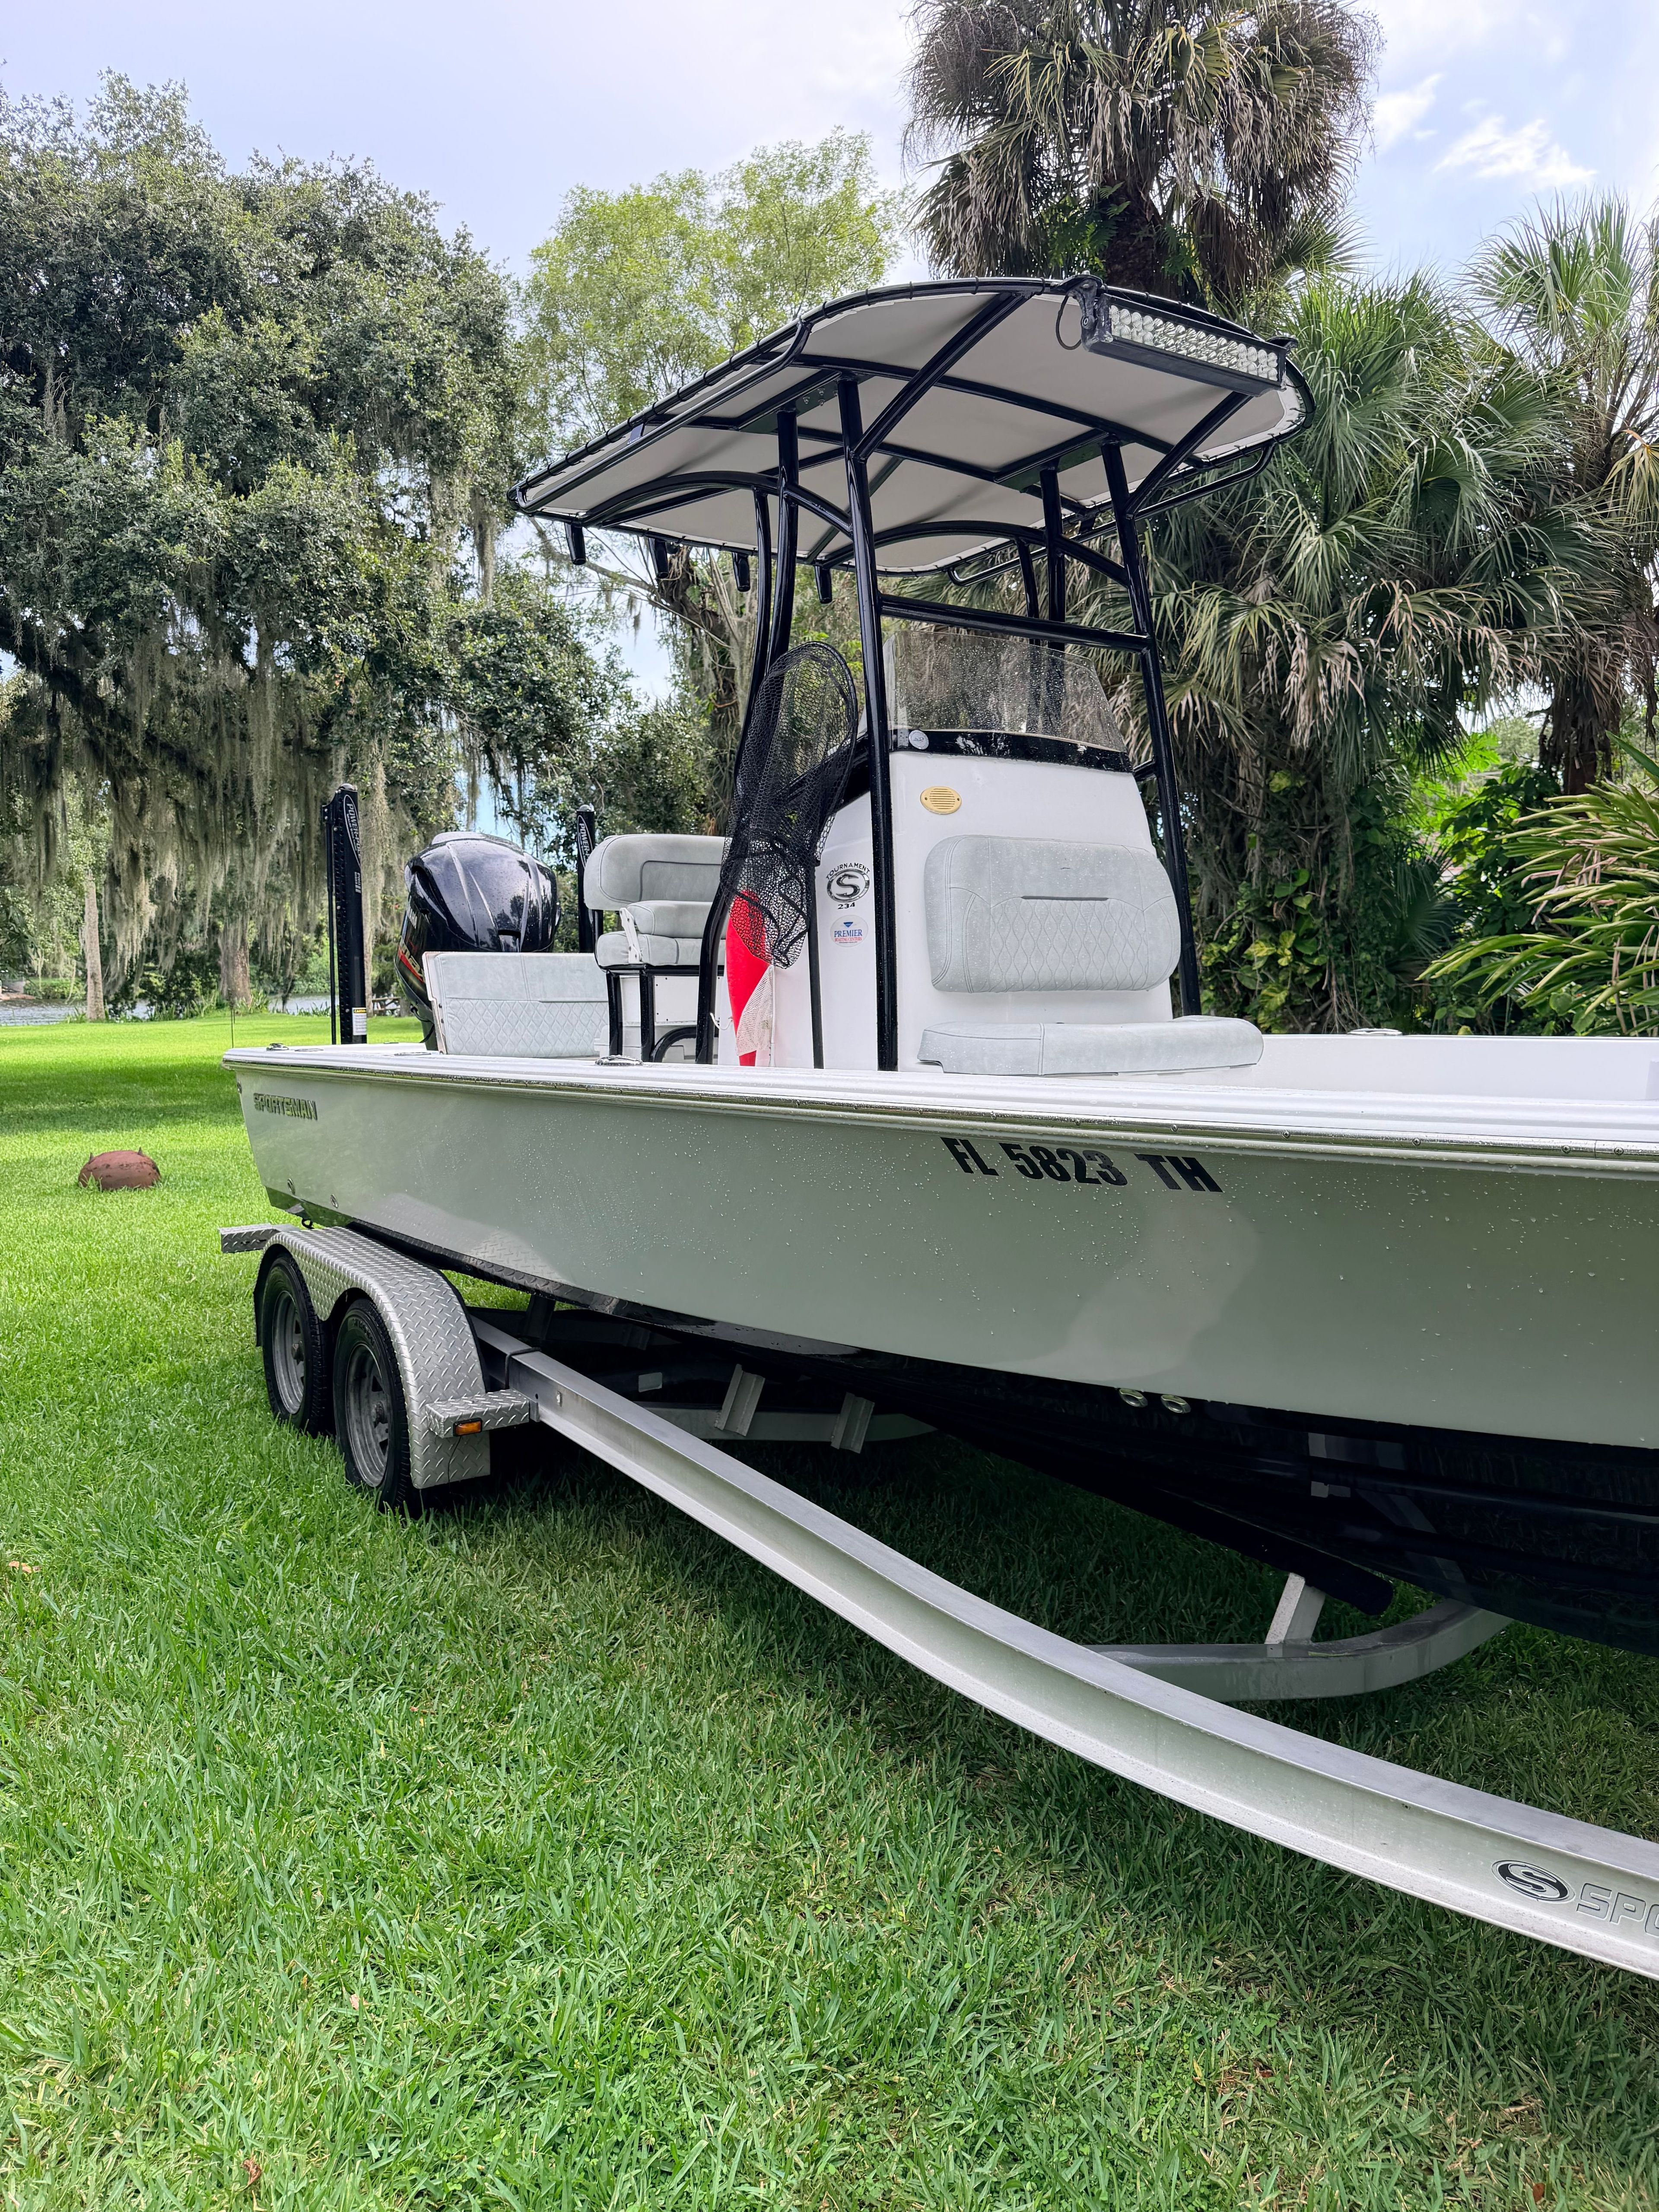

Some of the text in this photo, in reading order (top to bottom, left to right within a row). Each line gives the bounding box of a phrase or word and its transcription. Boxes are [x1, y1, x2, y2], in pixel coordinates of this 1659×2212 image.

[826, 862, 870, 880] TOURNAMENT
[254, 1093, 318, 1120] SPORTSMAN
[940, 1137, 1223, 1192] FL 5823 TH
